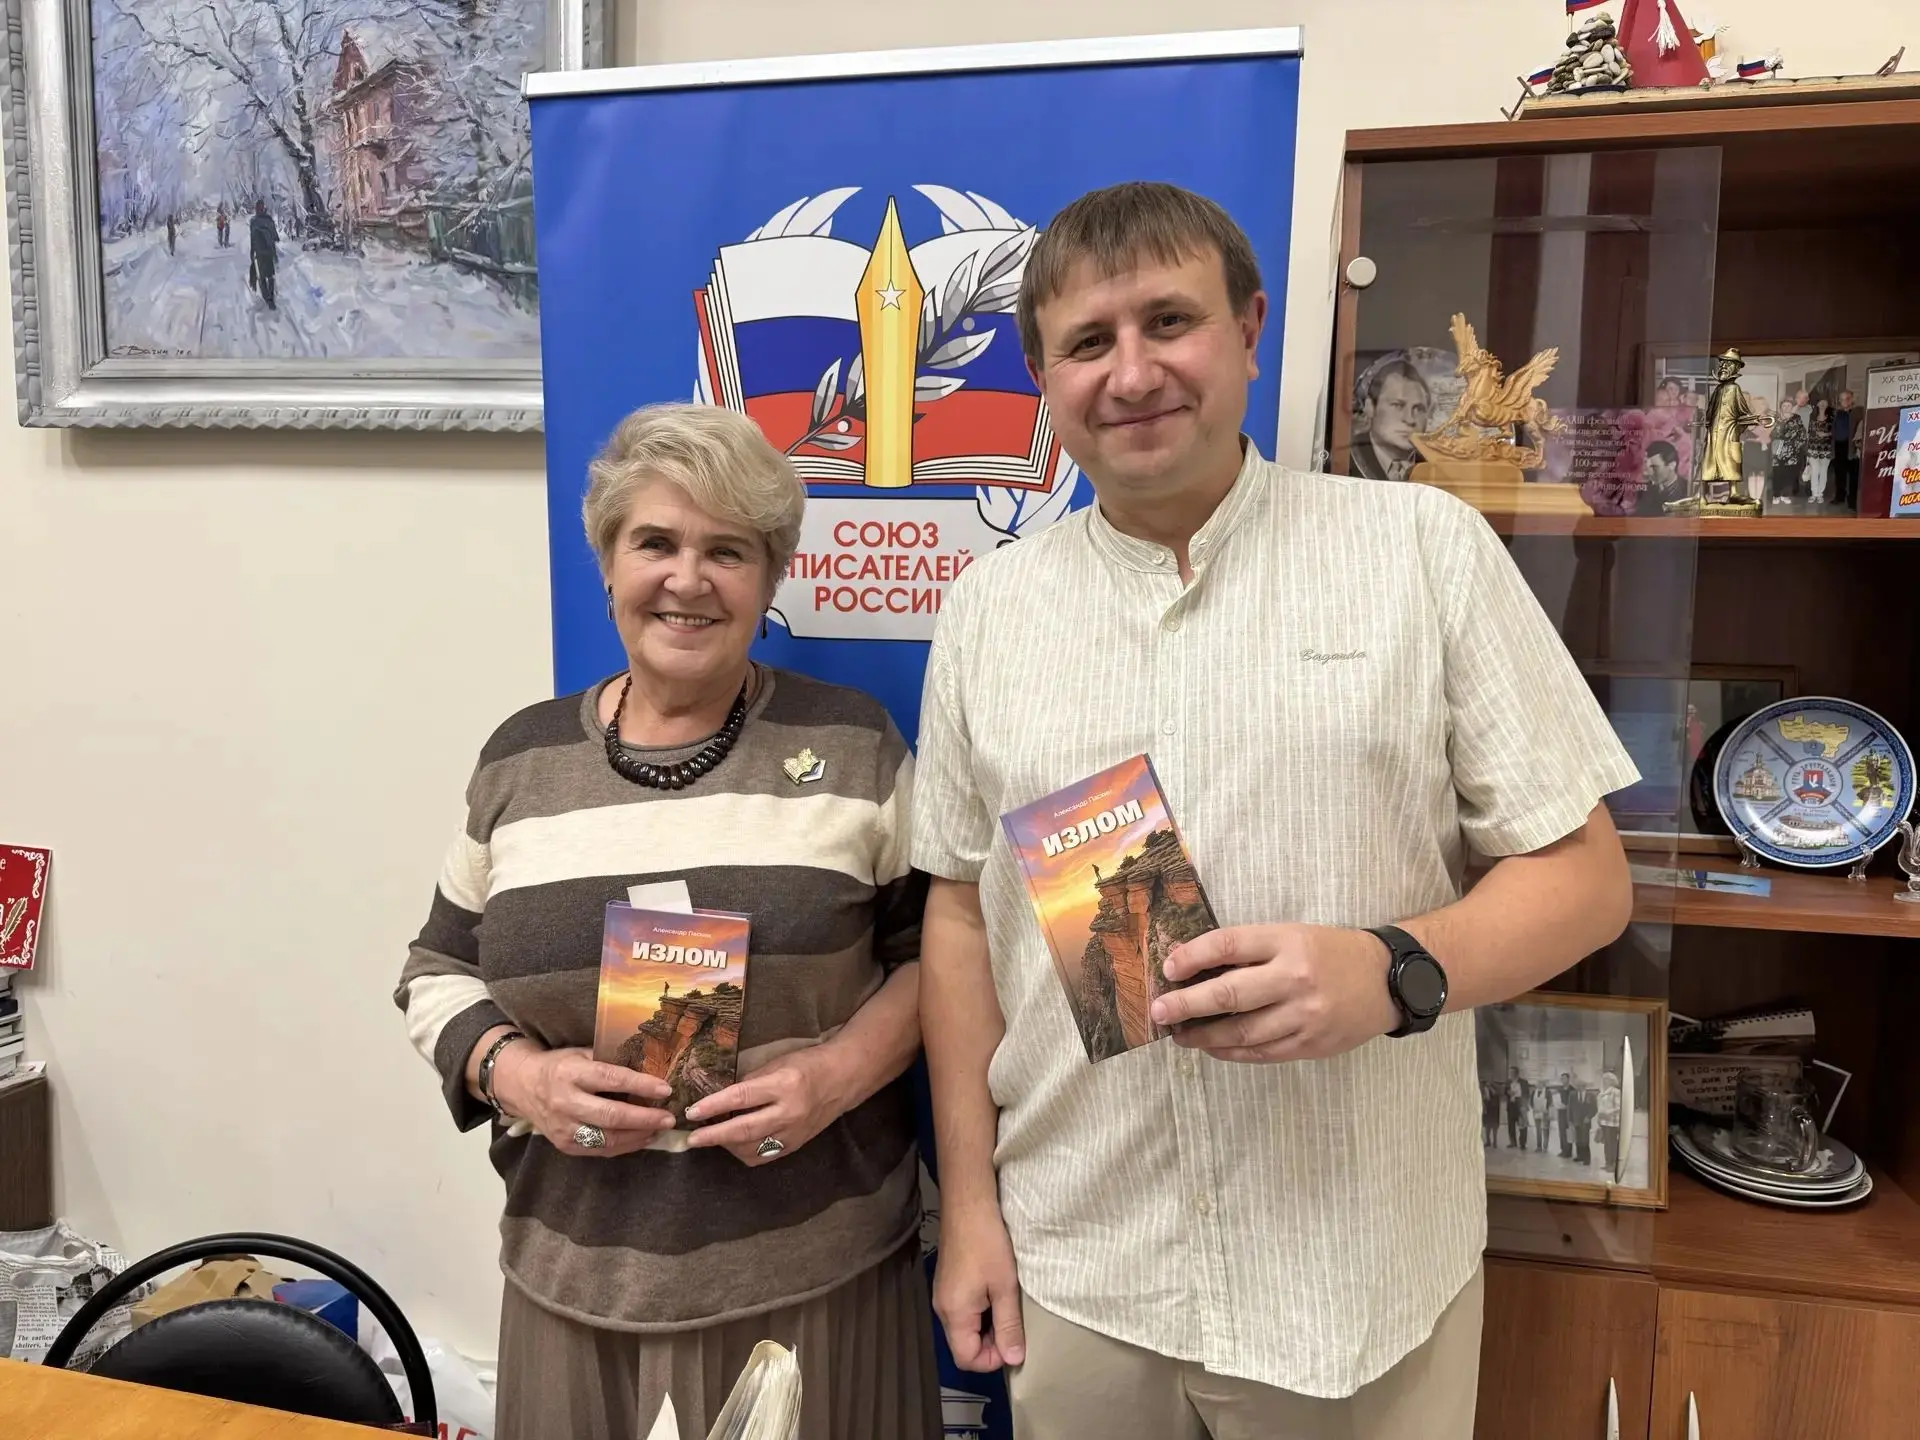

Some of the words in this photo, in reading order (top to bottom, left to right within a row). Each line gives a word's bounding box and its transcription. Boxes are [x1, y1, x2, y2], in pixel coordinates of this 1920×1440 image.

[1898, 374, 1920, 382] ФАТ
[833, 521, 939, 549] СОЮЗ
[789, 549, 975, 582] ПИСАТЕЛЕЙ
[1053, 799, 1089, 818] Александр
[1042, 799, 1144, 858] ИЗЛОМ
[652, 927, 688, 937] Александр
[632, 941, 728, 969] ИЗЛОМ
